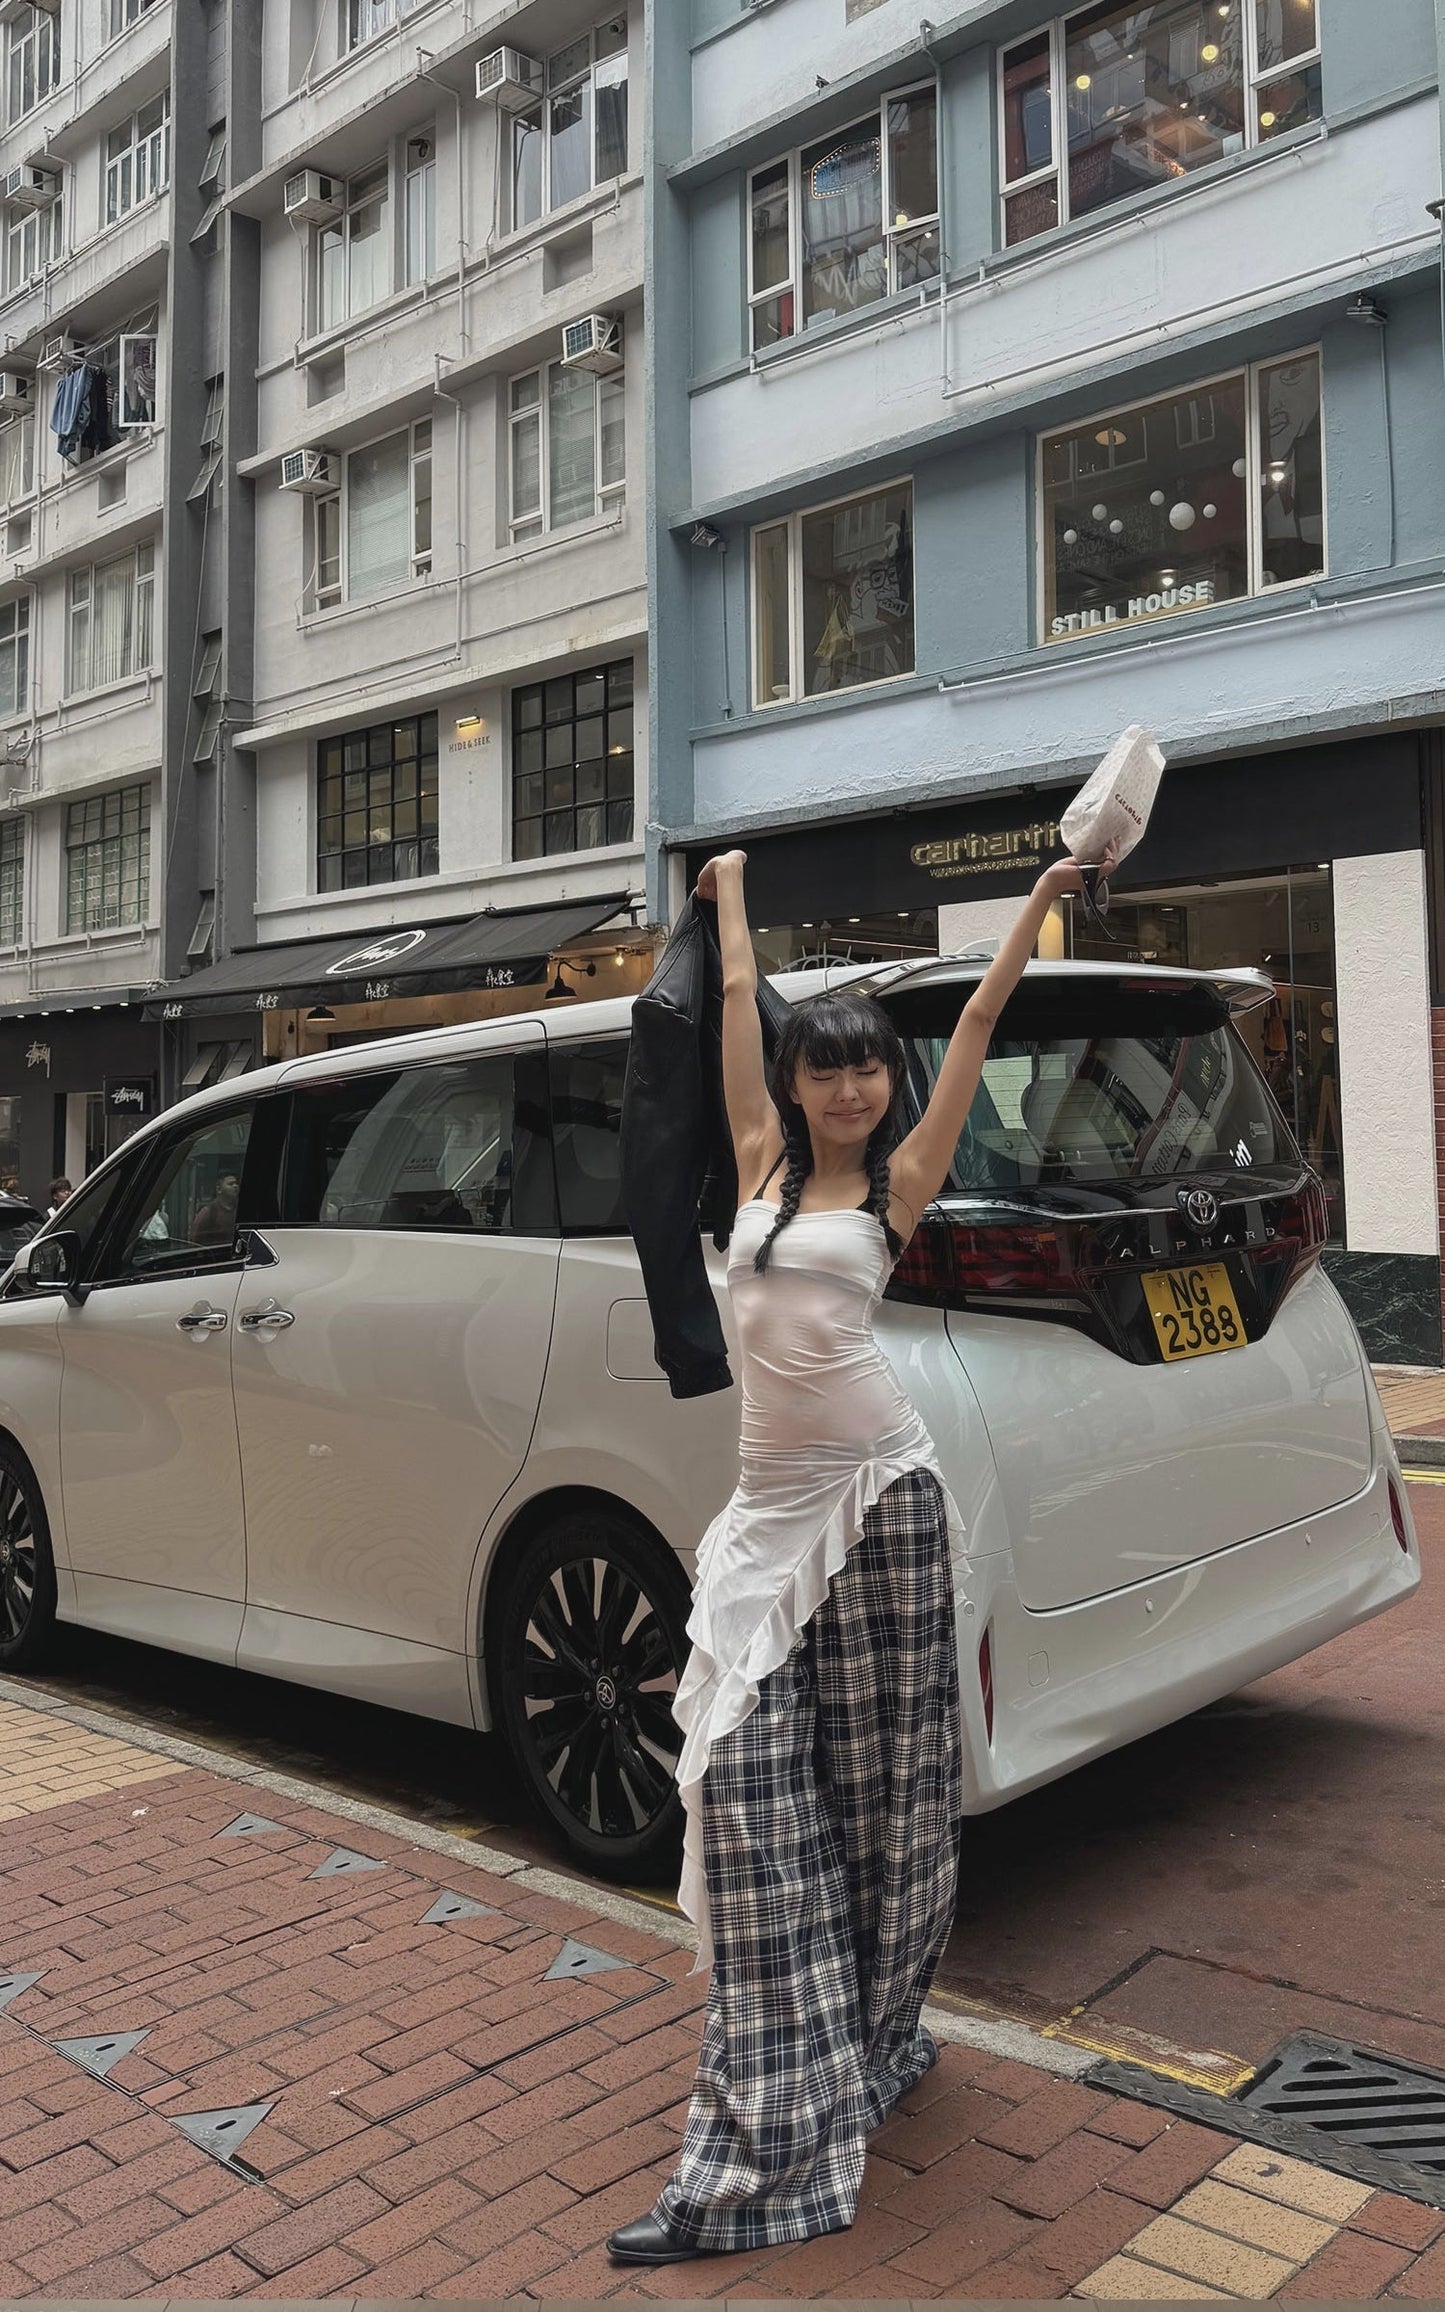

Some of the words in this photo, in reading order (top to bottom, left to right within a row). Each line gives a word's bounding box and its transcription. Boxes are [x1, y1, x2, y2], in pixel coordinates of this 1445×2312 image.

[1051, 605, 1118, 636] STILL
[1128, 580, 1214, 618] HOUSE
[910, 820, 1060, 866] carhartt
[1120, 1227, 1275, 1258] ALPHARD
[1167, 1269, 1212, 1311] NG
[1162, 1304, 1239, 1354] 2388
